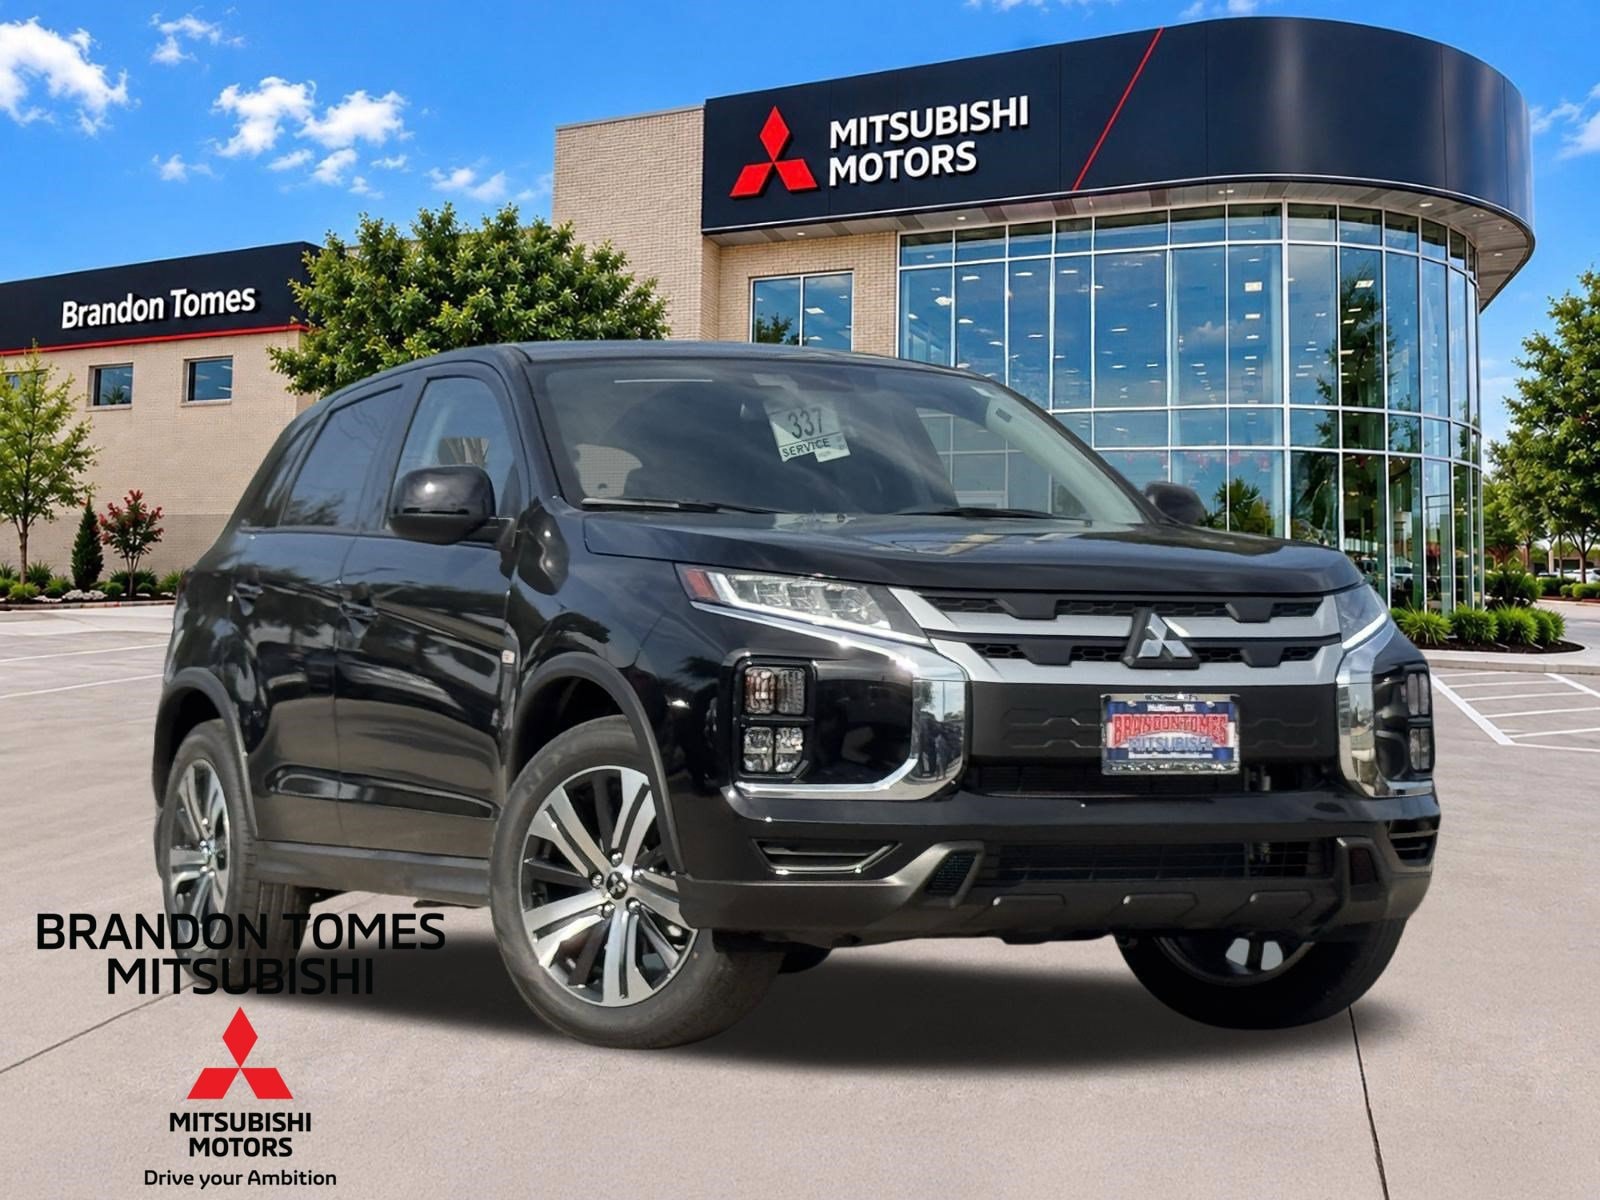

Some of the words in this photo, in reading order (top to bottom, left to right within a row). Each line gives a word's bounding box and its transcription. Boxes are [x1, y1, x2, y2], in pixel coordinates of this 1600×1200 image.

[829, 95, 1029, 149] MITSUBISHI
[828, 141, 977, 187] MOTORS
[61, 293, 164, 329] Brandon
[170, 287, 256, 318] Tomes
[788, 407, 823, 439] 337
[782, 438, 831, 457] SERVICE
[1128, 736, 1214, 752] MITSUBISHI
